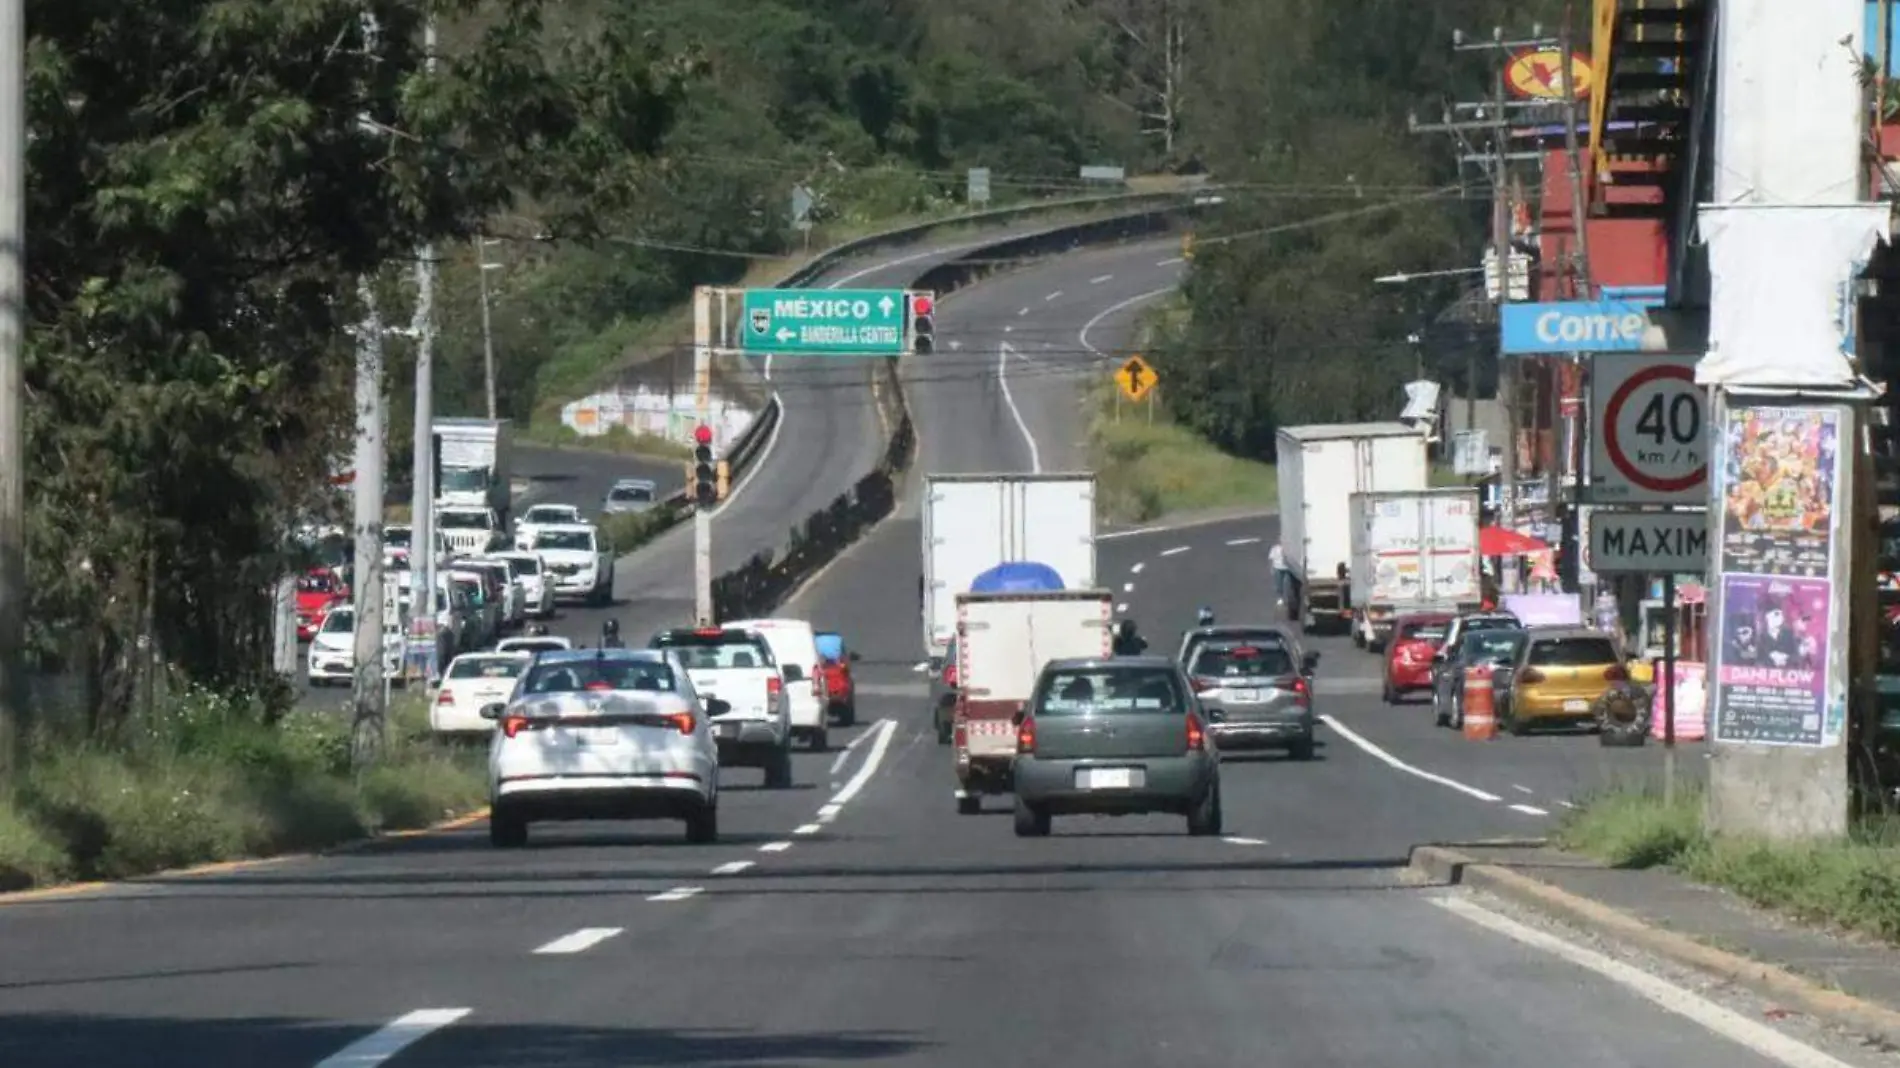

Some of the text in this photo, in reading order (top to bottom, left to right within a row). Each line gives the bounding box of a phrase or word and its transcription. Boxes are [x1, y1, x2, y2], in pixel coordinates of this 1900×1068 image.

[774, 296, 870, 319] MÉXICO
[860, 326, 898, 344] CENTRO
[1636, 391, 1700, 445] 40
[1603, 526, 1707, 557] MAXIM
[1731, 667, 1815, 683] DANI FLOW
